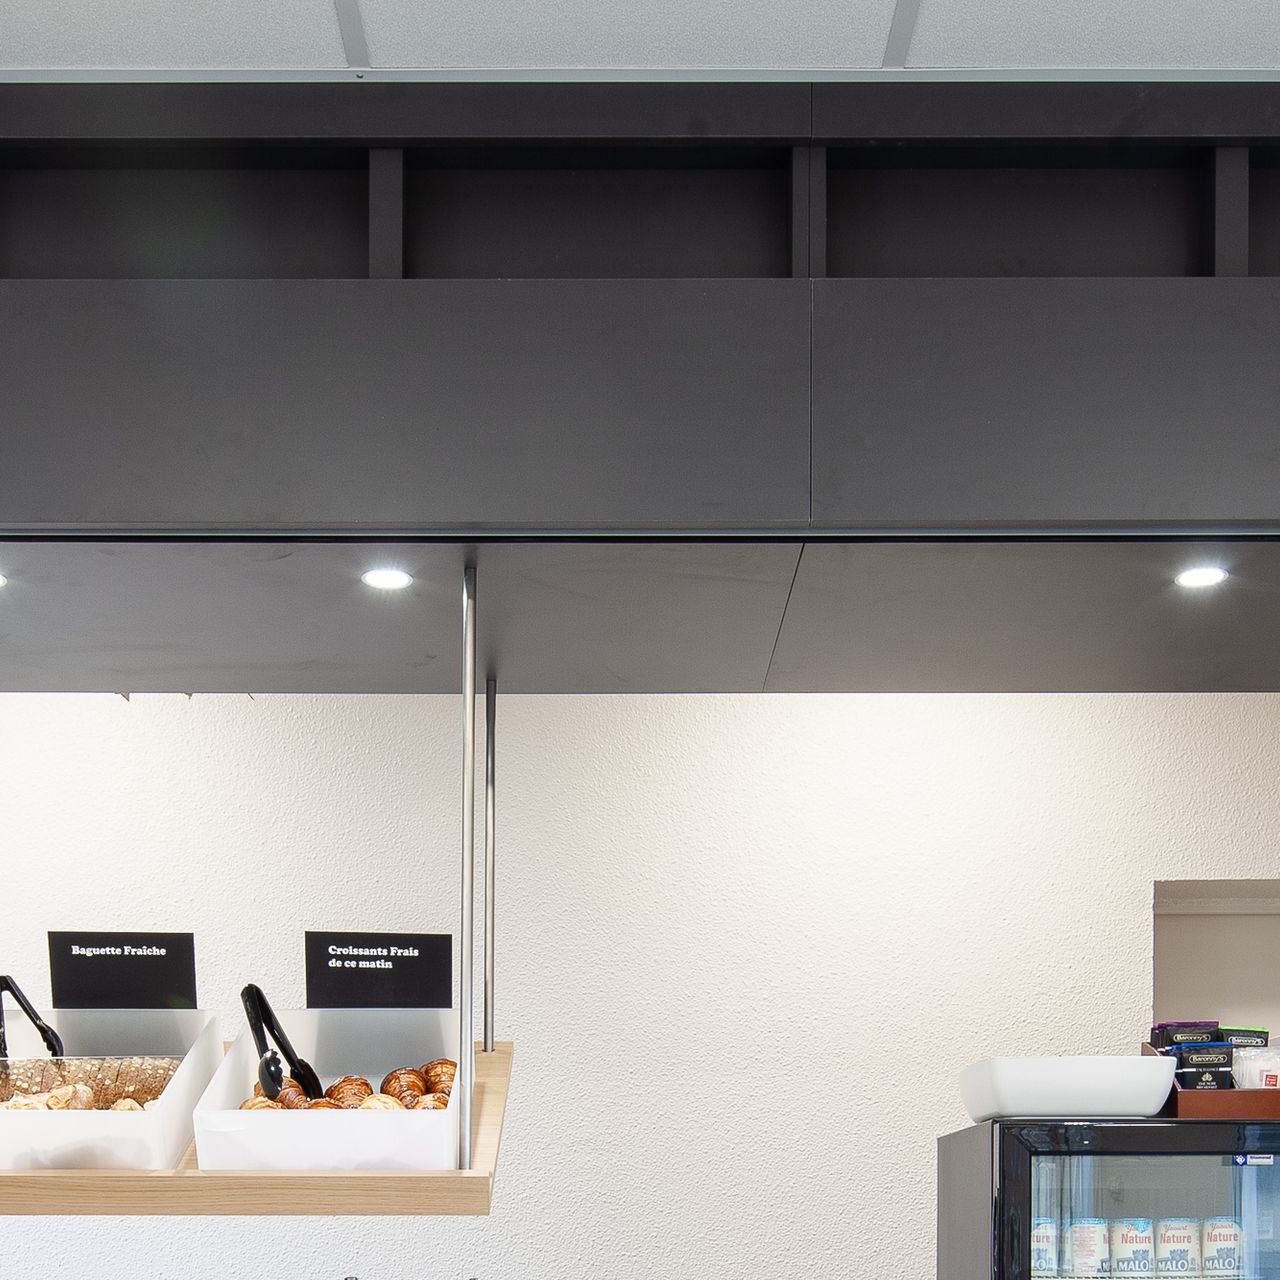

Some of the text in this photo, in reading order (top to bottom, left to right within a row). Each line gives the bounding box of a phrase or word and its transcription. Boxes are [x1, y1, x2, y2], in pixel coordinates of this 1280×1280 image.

[71, 945, 167, 957] Baguette Fraîche
[328, 945, 419, 957] Croissants Frais
[328, 958, 393, 969] de ce matin
[1121, 1233, 1152, 1244] Nature
[1160, 1233, 1192, 1244] Nature
[1207, 1231, 1239, 1243] Nature
[1119, 1260, 1149, 1272] MALO
[1158, 1260, 1189, 1272] MALO
[1206, 1258, 1235, 1271] MALO
